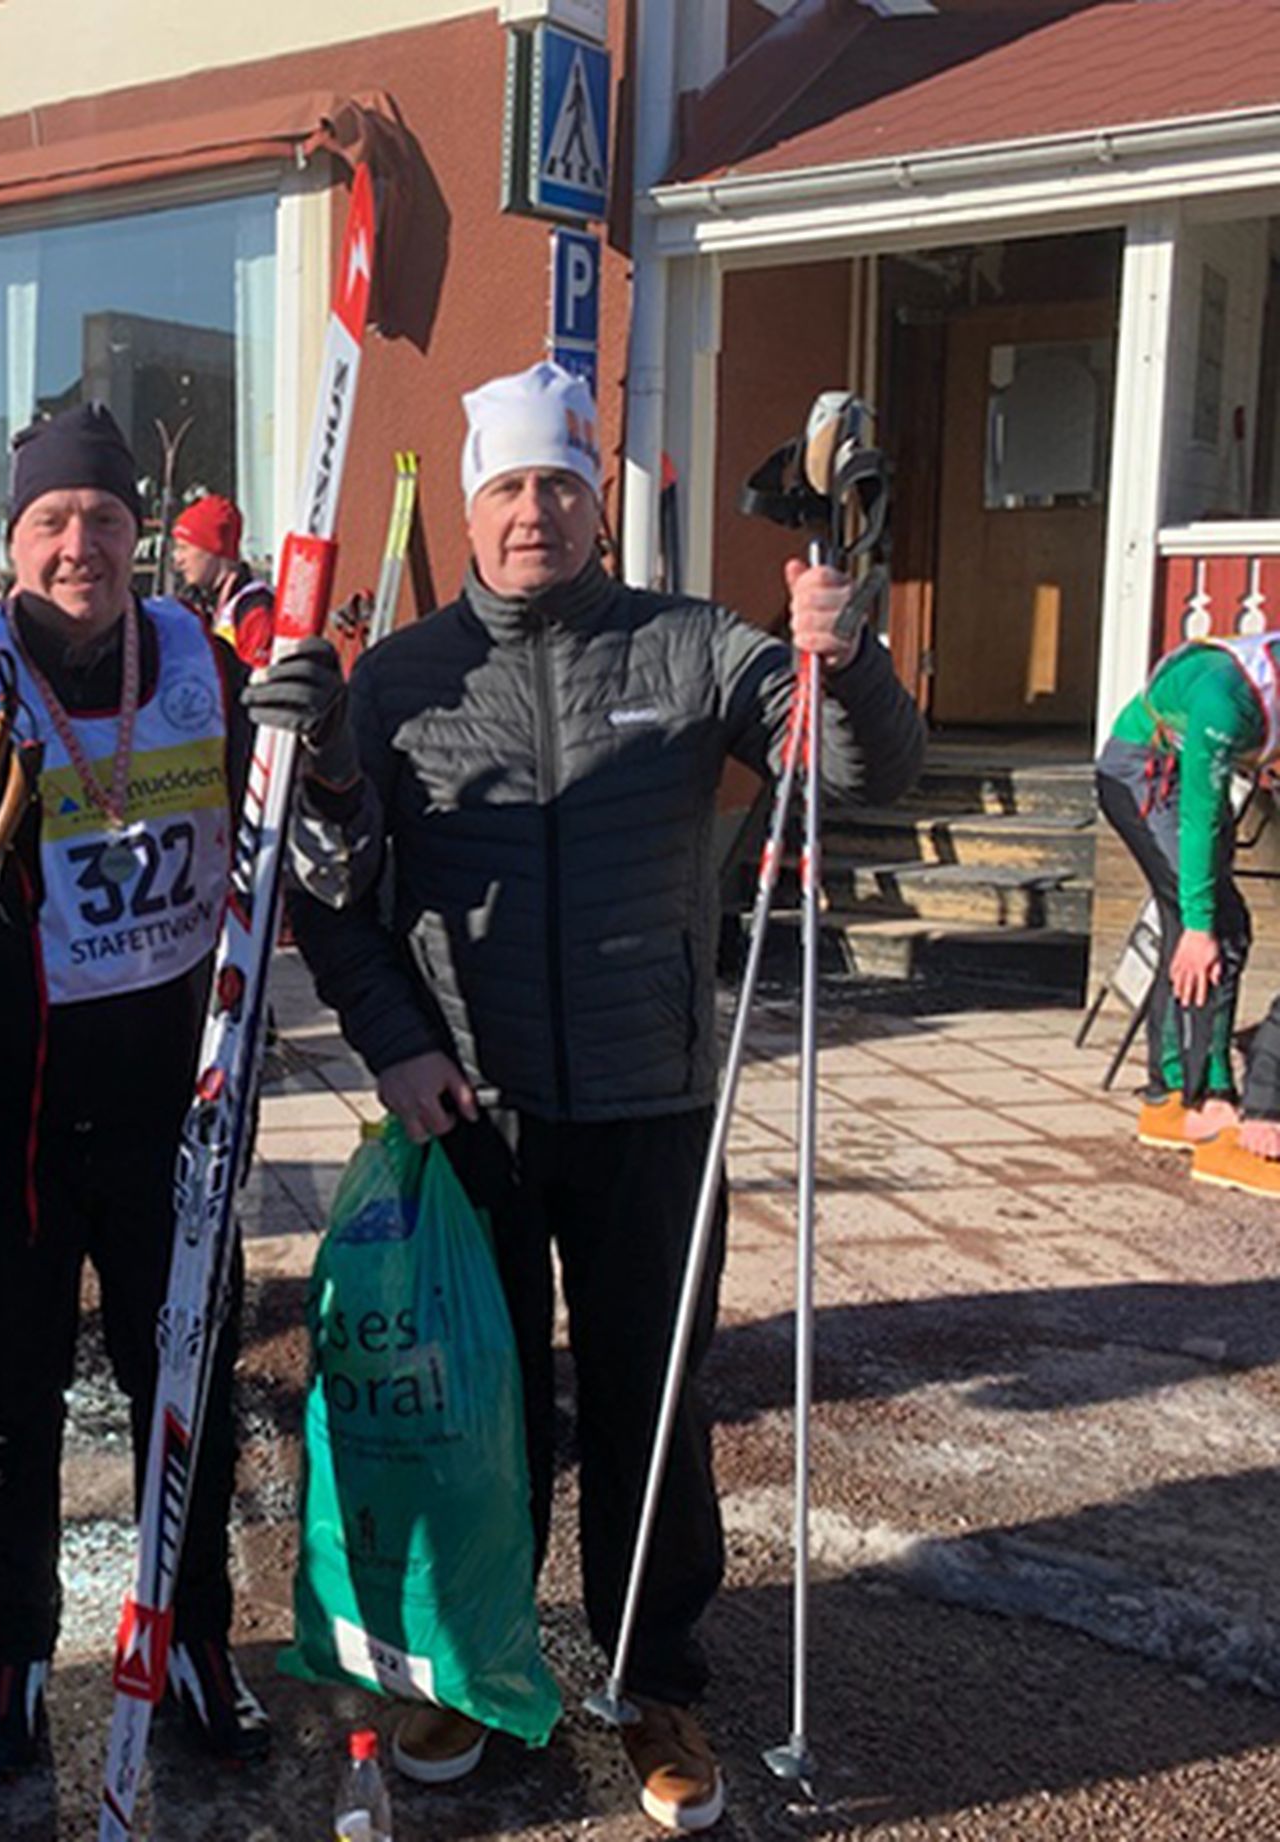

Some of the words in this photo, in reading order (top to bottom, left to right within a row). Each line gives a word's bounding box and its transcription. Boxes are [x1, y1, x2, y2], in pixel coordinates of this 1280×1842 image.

[565, 242, 593, 330] P
[68, 821, 197, 926] 322
[329, 1355, 445, 1417] ora!
